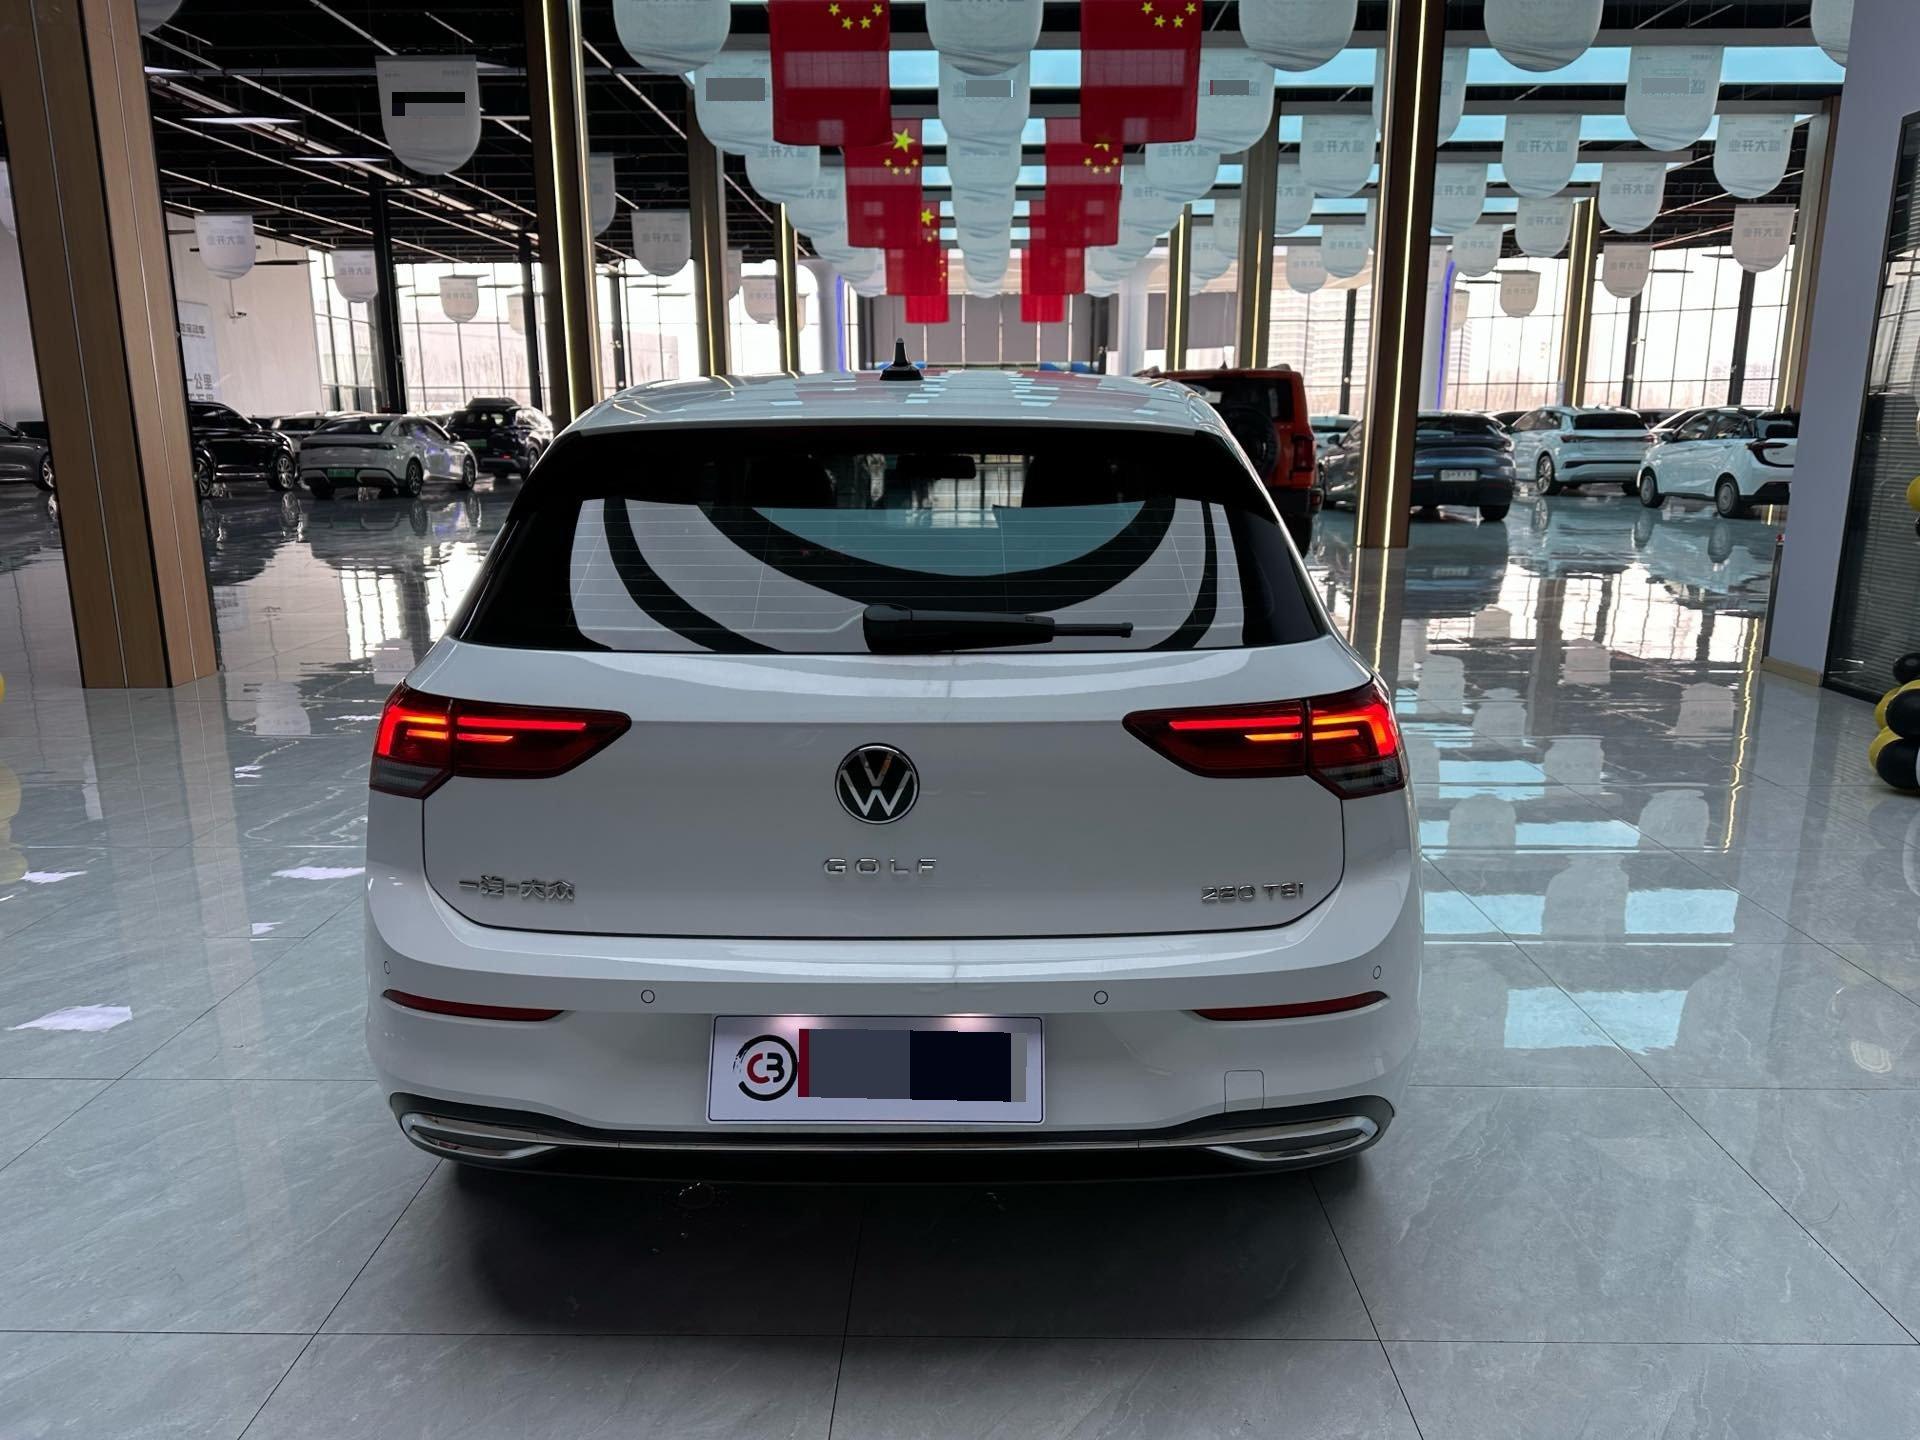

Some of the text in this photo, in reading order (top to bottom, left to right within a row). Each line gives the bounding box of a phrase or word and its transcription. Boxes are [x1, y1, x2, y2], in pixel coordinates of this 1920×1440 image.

[823, 858, 937, 875] GOLF
[1201, 882, 1304, 902] 280 TSI
